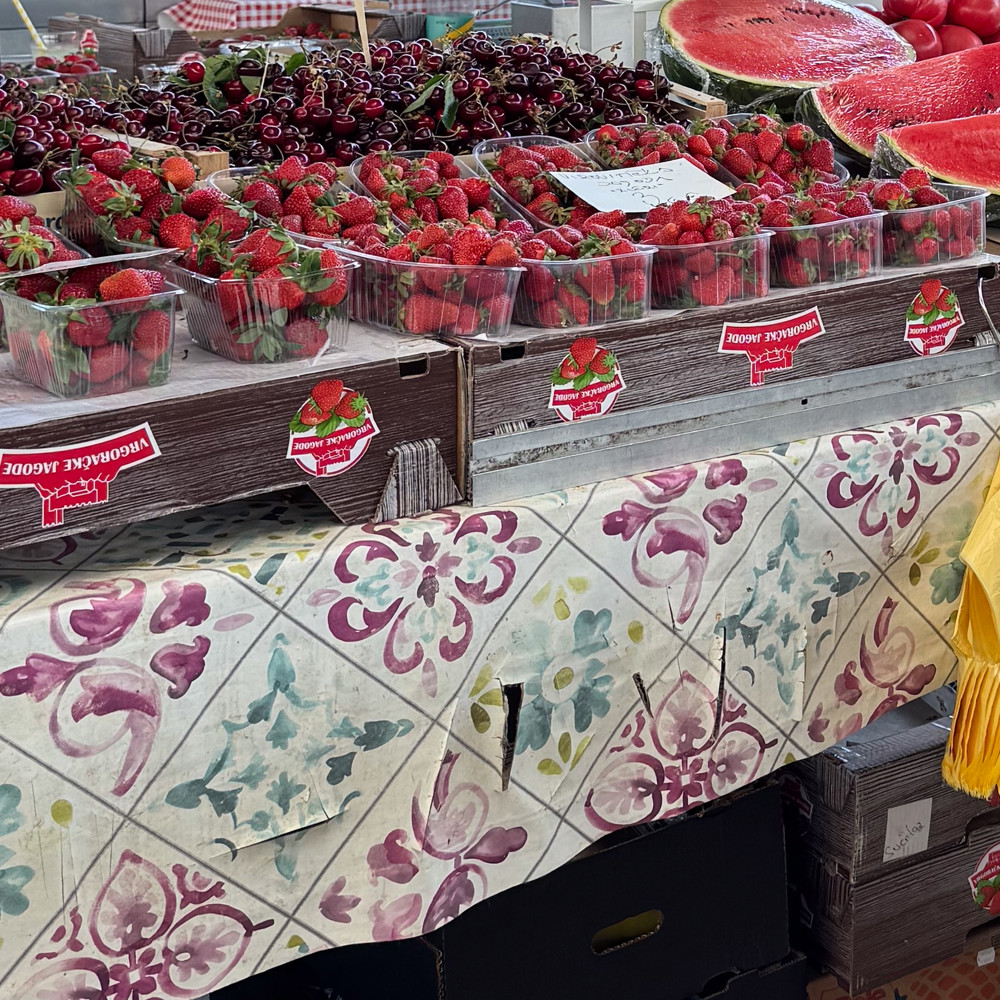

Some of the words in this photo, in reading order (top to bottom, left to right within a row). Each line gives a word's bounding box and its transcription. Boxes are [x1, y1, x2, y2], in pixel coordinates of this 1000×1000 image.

[725, 332, 762, 344] JAGODE
[764, 317, 819, 343] VRGORAČKE
[325, 423, 372, 446] VRGORAČKE
[63, 437, 149, 471] VRGORAČKE
[293, 439, 325, 450] JAGODE
[2, 461, 59, 476] JAGODE
